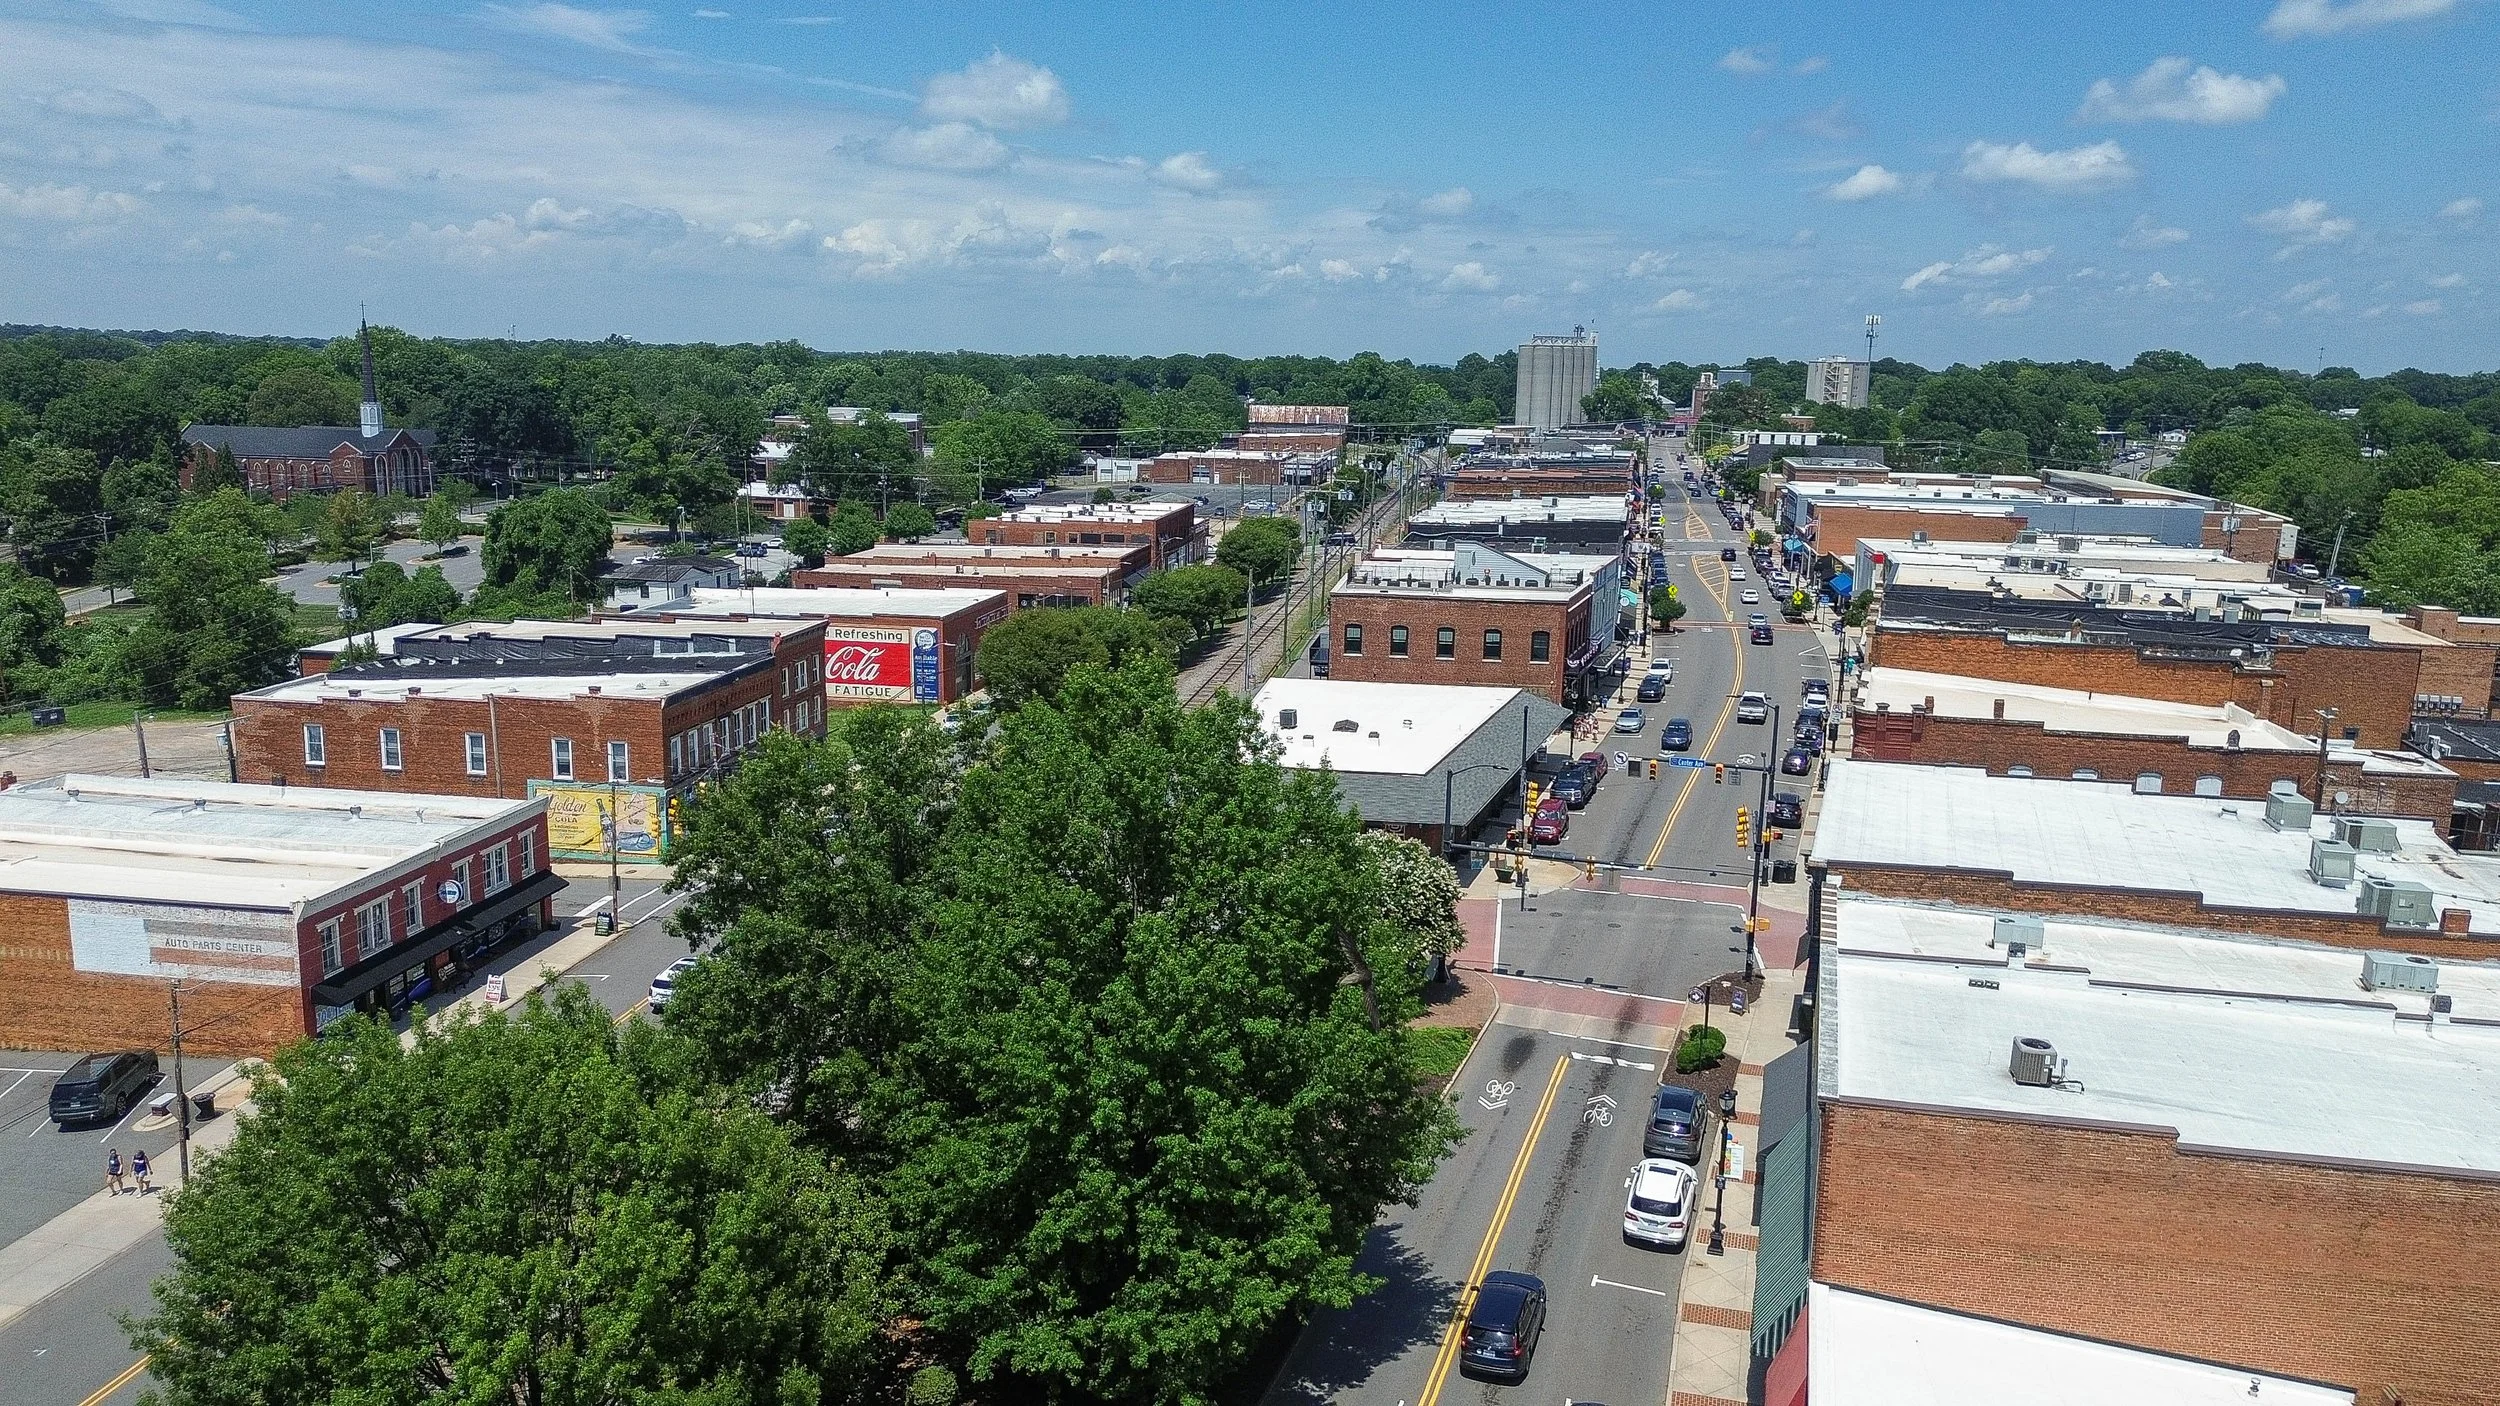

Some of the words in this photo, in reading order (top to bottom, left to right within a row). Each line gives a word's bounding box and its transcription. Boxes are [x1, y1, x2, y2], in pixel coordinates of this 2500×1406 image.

[835, 628, 903, 642] Refreshing
[835, 685, 892, 697] FATIGUE
[548, 794, 587, 819] Golden
[165, 938, 189, 949] AUTO
[193, 940, 222, 951] PARTS
[226, 943, 262, 954] CENTER
